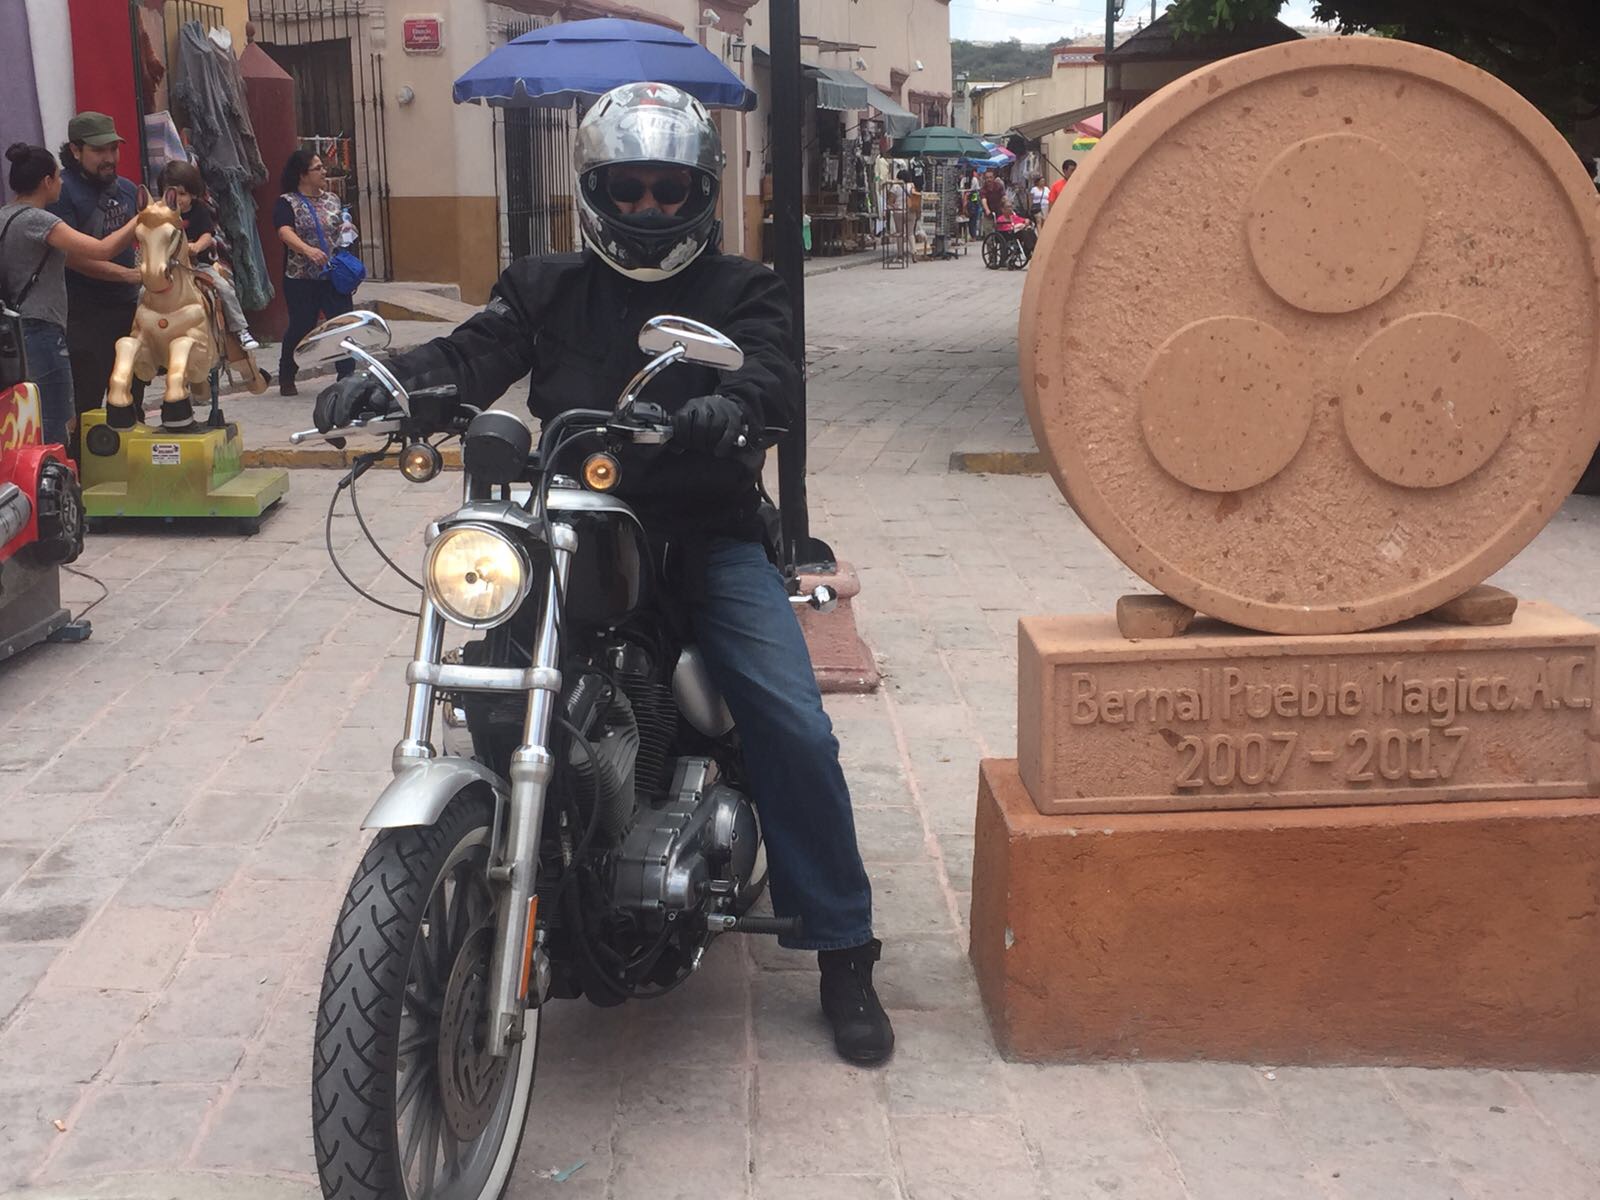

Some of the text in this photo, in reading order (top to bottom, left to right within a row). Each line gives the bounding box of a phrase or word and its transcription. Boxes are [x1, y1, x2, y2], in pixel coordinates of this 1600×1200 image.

[1070, 668, 1210, 725] Bernal
[1222, 664, 1363, 719] Pueblo
[1175, 730, 1298, 788] 2007
[1346, 726, 1470, 782] 2017
